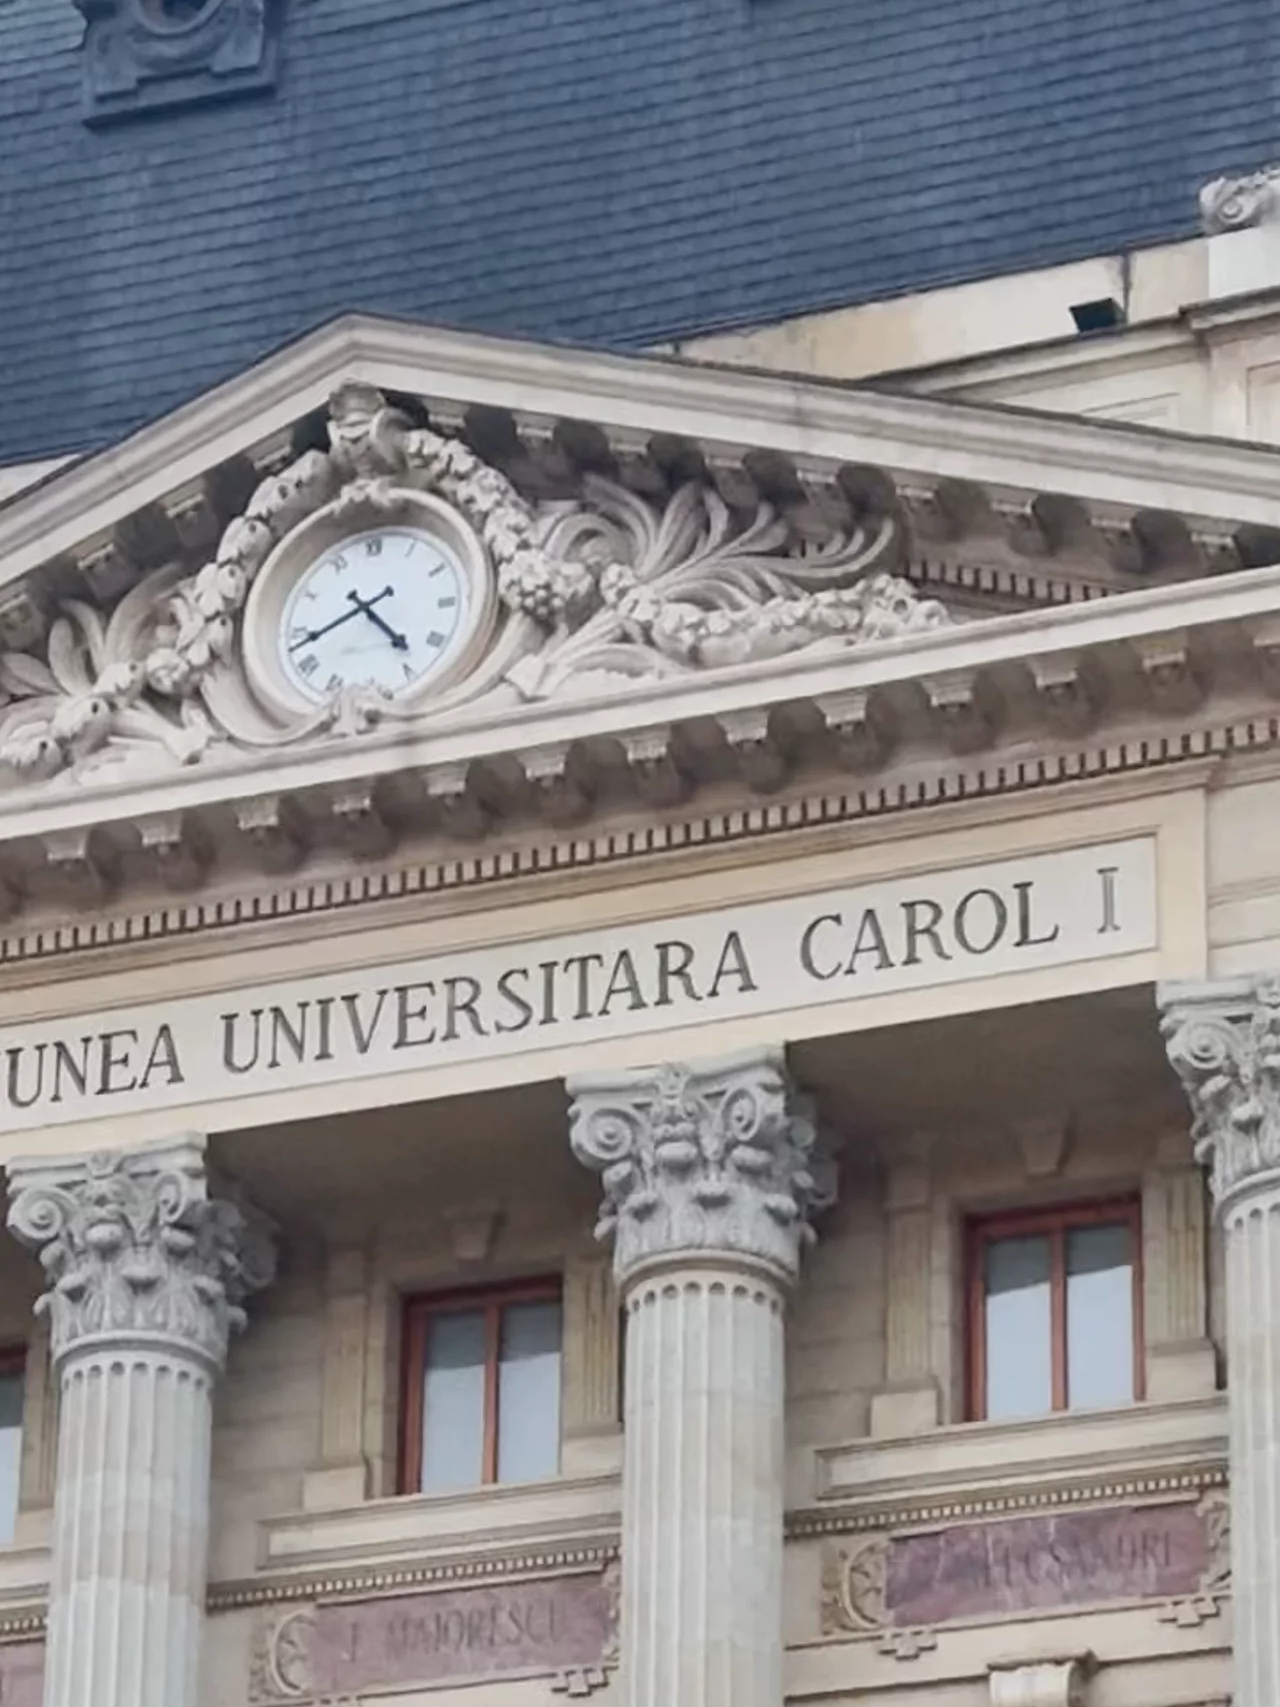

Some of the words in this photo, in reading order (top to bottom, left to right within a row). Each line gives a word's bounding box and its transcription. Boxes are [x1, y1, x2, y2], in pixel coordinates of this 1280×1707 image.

[220, 930, 759, 1074] UNIVERSITARA
[800, 880, 1061, 981] CAROL
[1095, 866, 1122, 934] I
